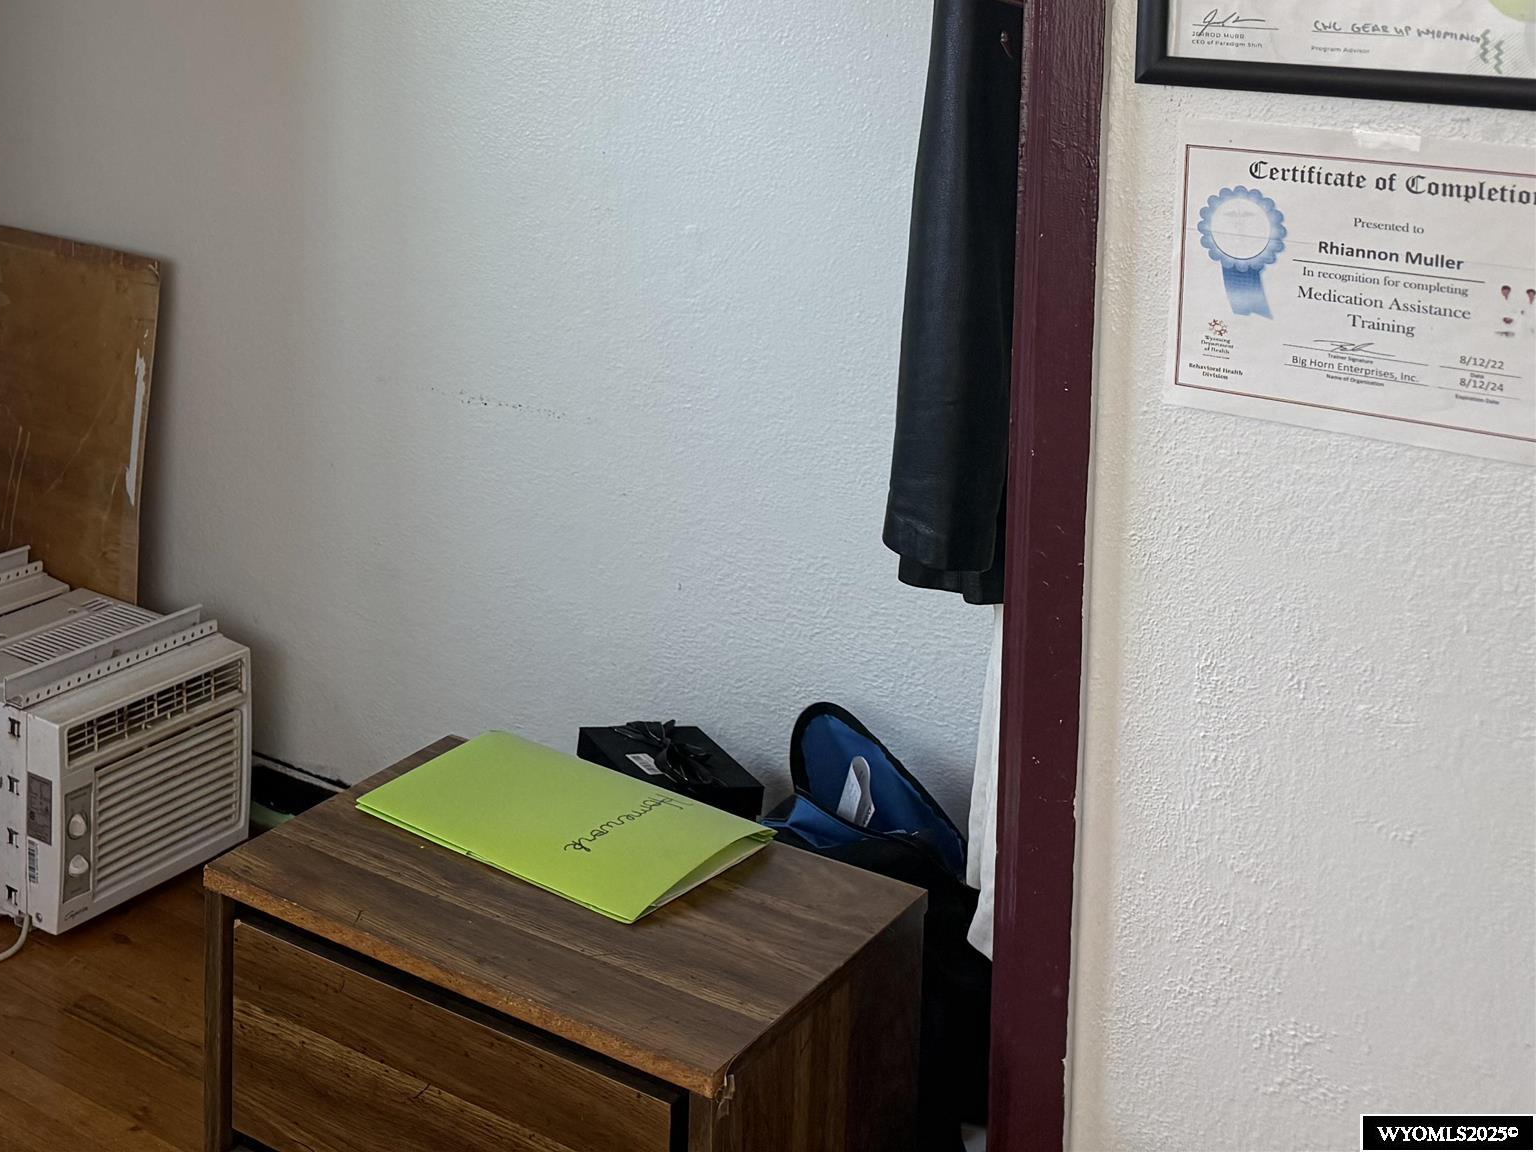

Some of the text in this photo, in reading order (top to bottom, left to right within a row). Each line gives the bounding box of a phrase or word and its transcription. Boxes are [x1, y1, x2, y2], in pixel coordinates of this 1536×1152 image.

[1351, 23, 1389, 33] GEAR
[1248, 161, 1366, 189] Certificate
[1375, 173, 1396, 192] of
[1353, 217, 1425, 235] Presented to
[1318, 241, 1464, 270] Rhiannon Muller
[1302, 266, 1469, 297] In recognition for completing
[1297, 285, 1471, 320] Medication Assistance
[1347, 313, 1415, 338] Training
[1291, 355, 1420, 382] Big Horn Enterprises, Inc.
[1459, 355, 1504, 370] 8/12/22
[1459, 377, 1504, 392] 8/12/24
